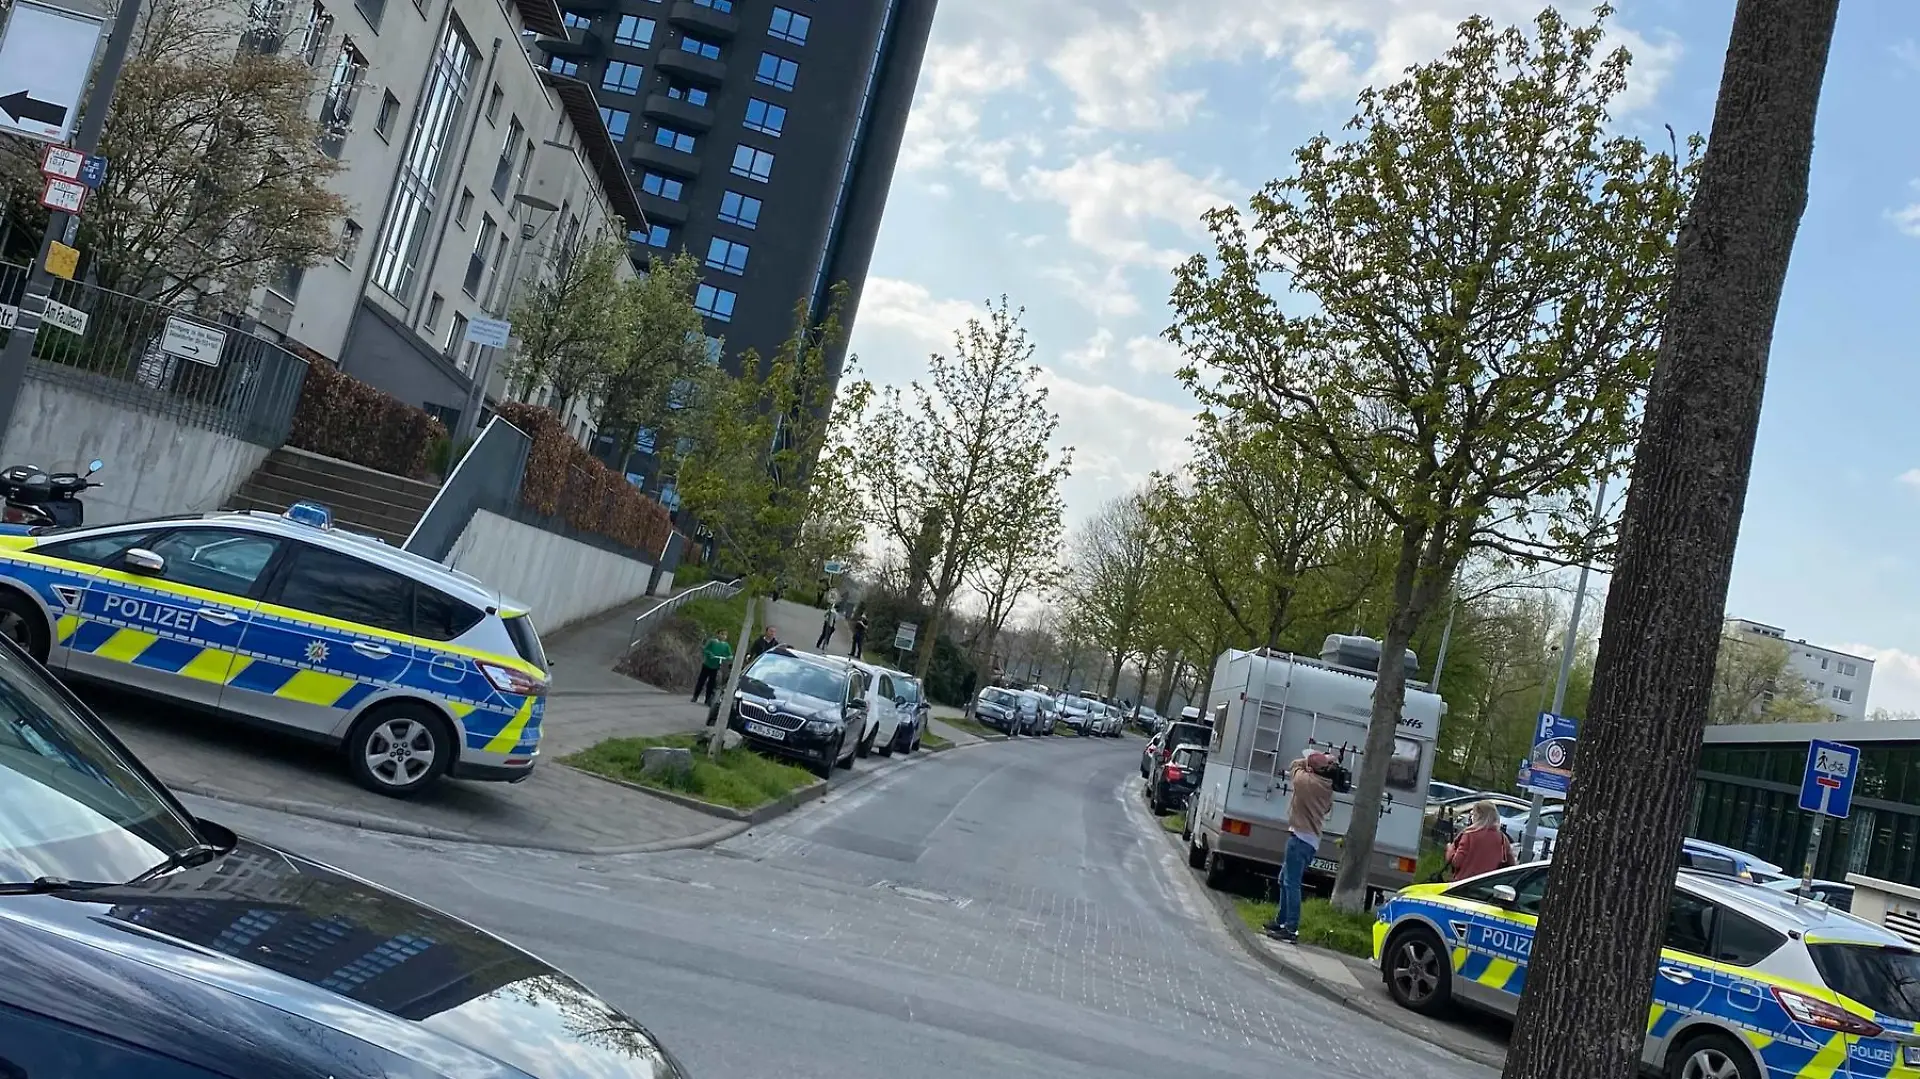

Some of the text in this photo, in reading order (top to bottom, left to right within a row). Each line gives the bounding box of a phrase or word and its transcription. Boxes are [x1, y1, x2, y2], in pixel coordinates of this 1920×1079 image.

[103, 593, 198, 632] POLIZEI
[1482, 928, 1533, 956] POLIZ
[1850, 1044, 1893, 1062] POLIZEI
